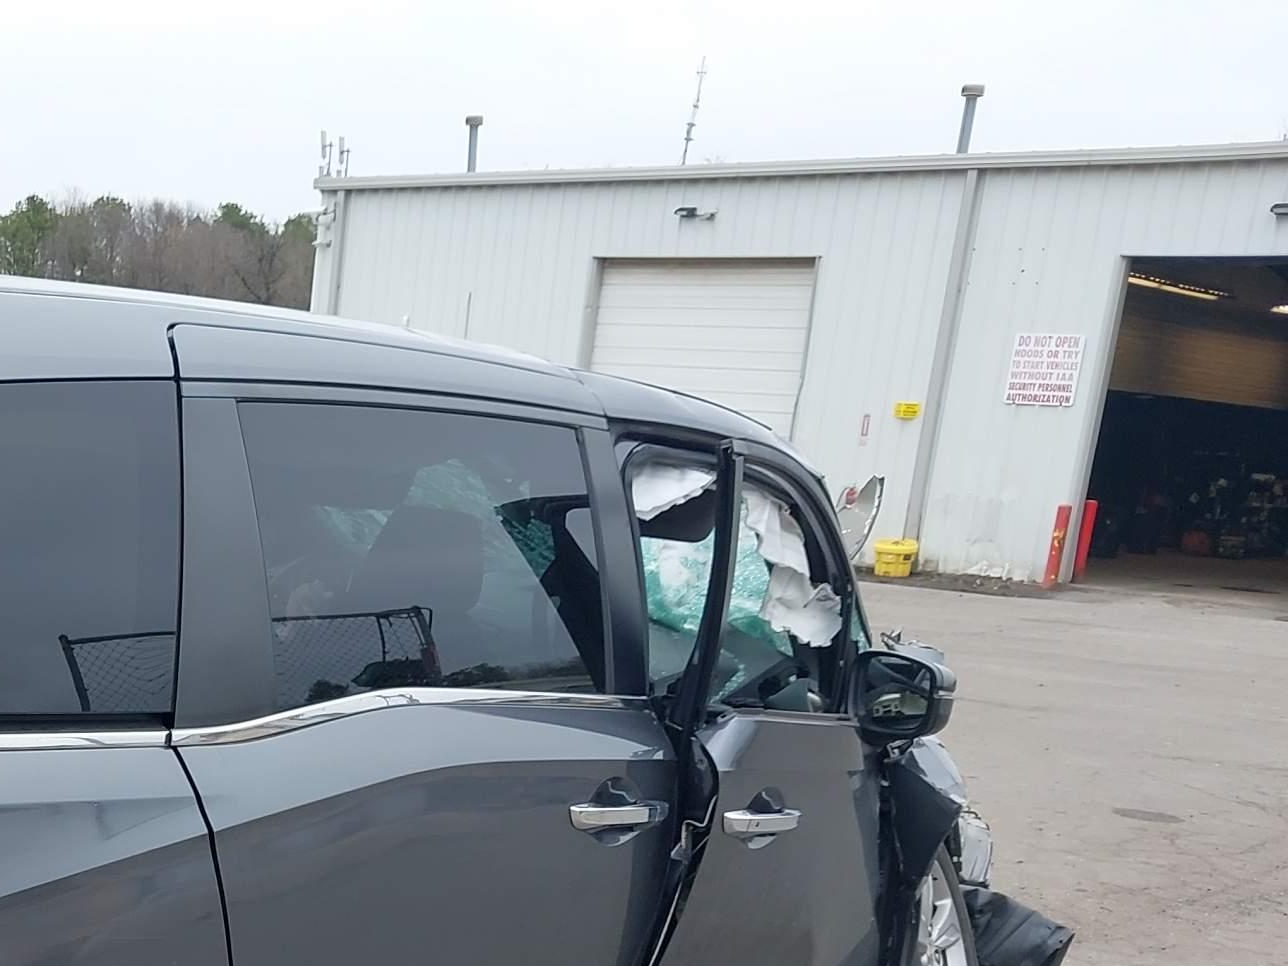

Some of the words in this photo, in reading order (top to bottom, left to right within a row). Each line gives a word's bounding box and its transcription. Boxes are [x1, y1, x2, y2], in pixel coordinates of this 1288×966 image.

[1018, 335, 1032, 347] DO
[1033, 336, 1053, 347] NOT
[1055, 336, 1081, 349] OPEN
[1014, 349, 1044, 359] HOODS
[1046, 350, 1060, 359] OR
[1062, 350, 1081, 360] TRY
[1012, 360, 1022, 369] TO
[1022, 360, 1044, 370] START
[1046, 361, 1079, 371] VEHICLES
[1010, 371, 1054, 381] WITHOUT
[1056, 372, 1074, 381] IAA
[1008, 382, 1037, 392] SECURITY
[1037, 383, 1073, 393] PERSONNEL
[1006, 393, 1072, 404] AUTHORIZATION
